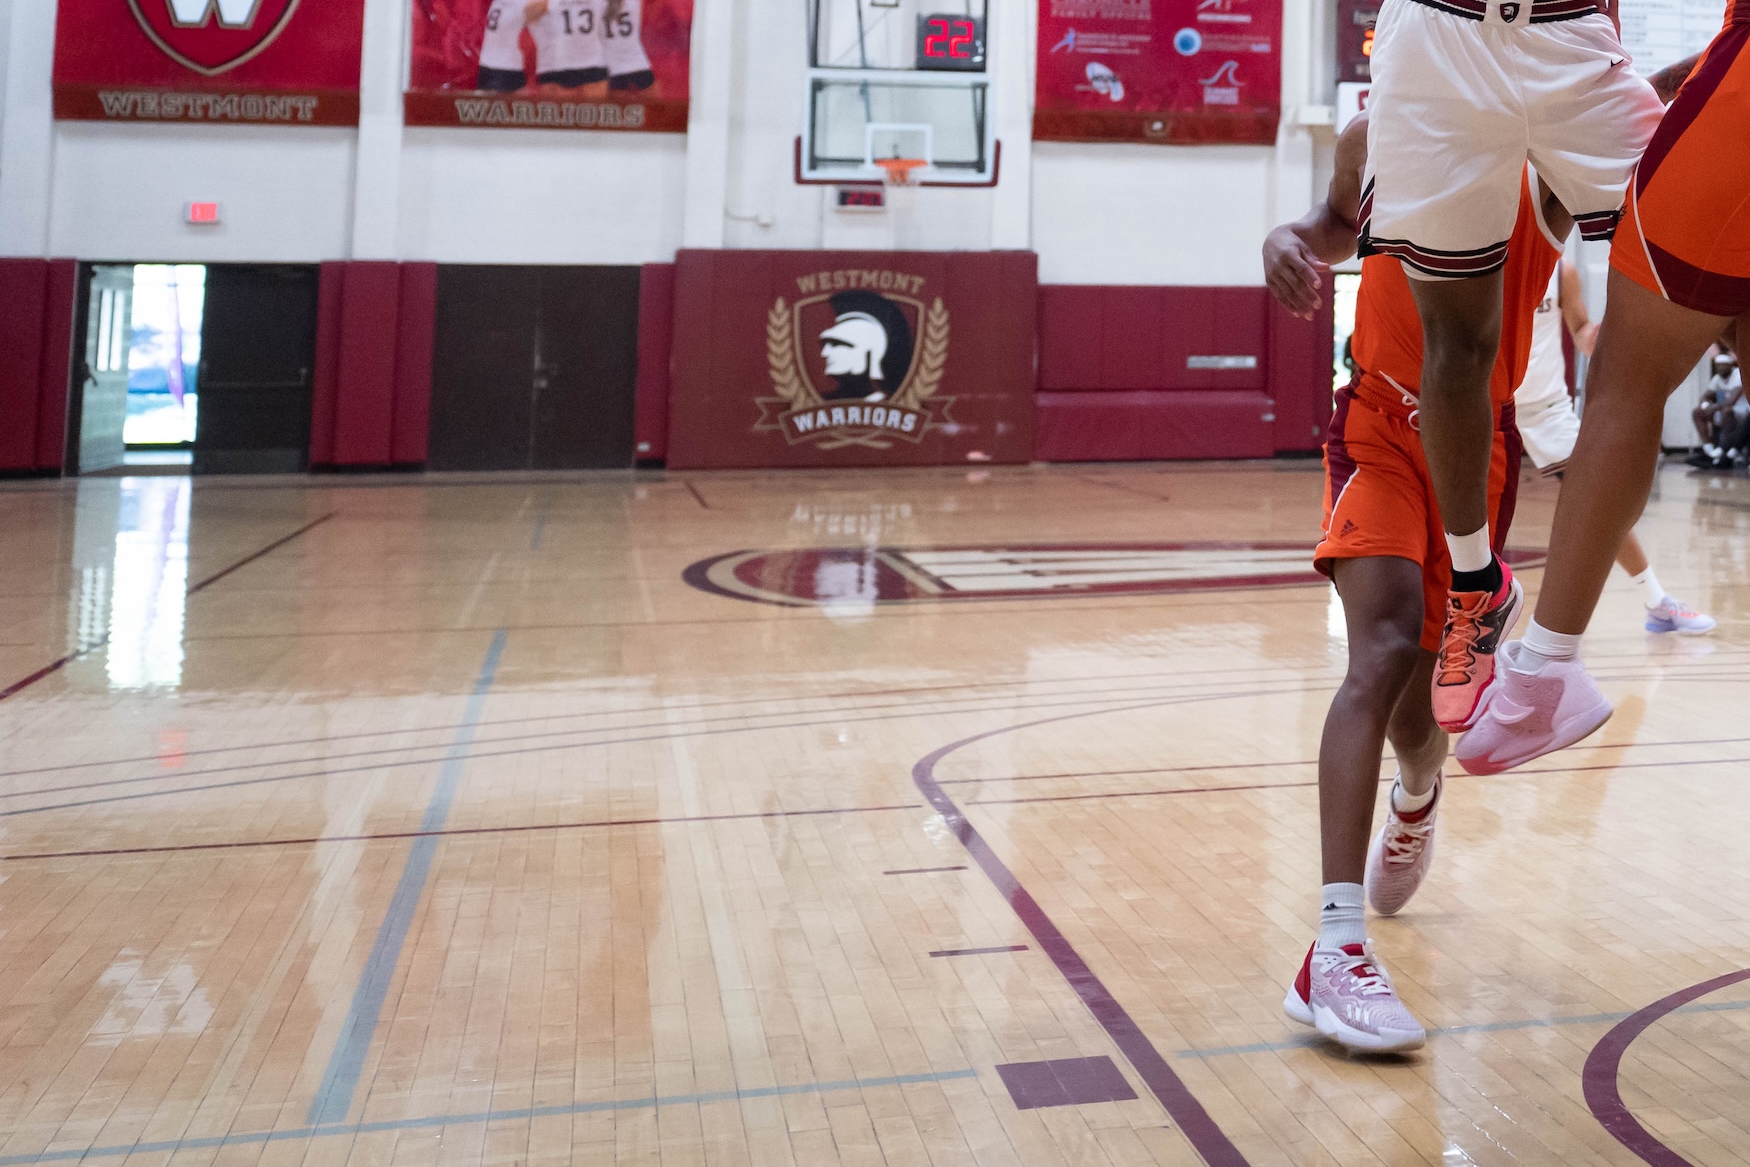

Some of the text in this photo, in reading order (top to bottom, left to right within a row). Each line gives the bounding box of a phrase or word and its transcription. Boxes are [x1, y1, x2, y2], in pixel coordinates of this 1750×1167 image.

[561, 9, 593, 35] 13
[924, 19, 974, 59] 22
[98, 91, 318, 121] WESTMONT
[455, 99, 645, 127] WARRIORS
[796, 269, 926, 293] WESTMONT
[792, 406, 918, 432] WARRIORS
